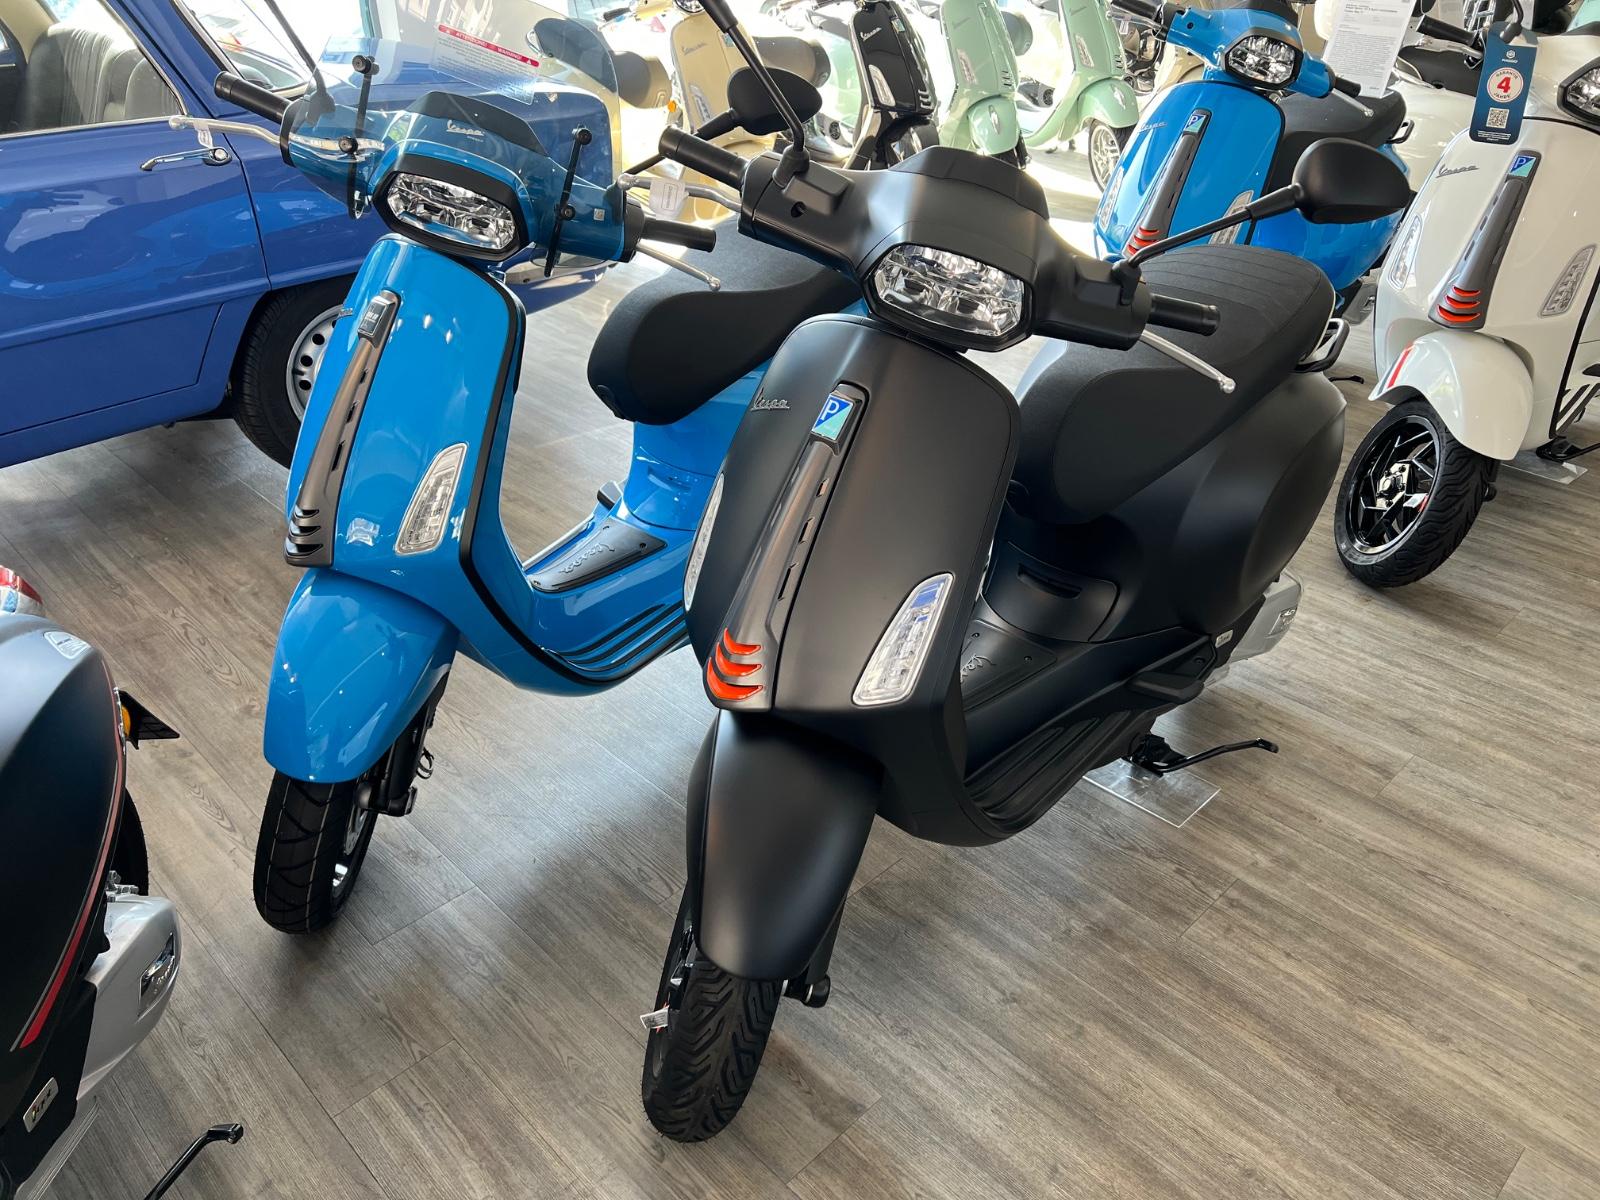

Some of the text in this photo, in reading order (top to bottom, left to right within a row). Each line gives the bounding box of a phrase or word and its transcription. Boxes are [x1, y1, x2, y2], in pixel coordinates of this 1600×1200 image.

[1497, 76, 1511, 93] 4
[1435, 163, 1480, 179] Vespa
[749, 387, 791, 412] Vespa
